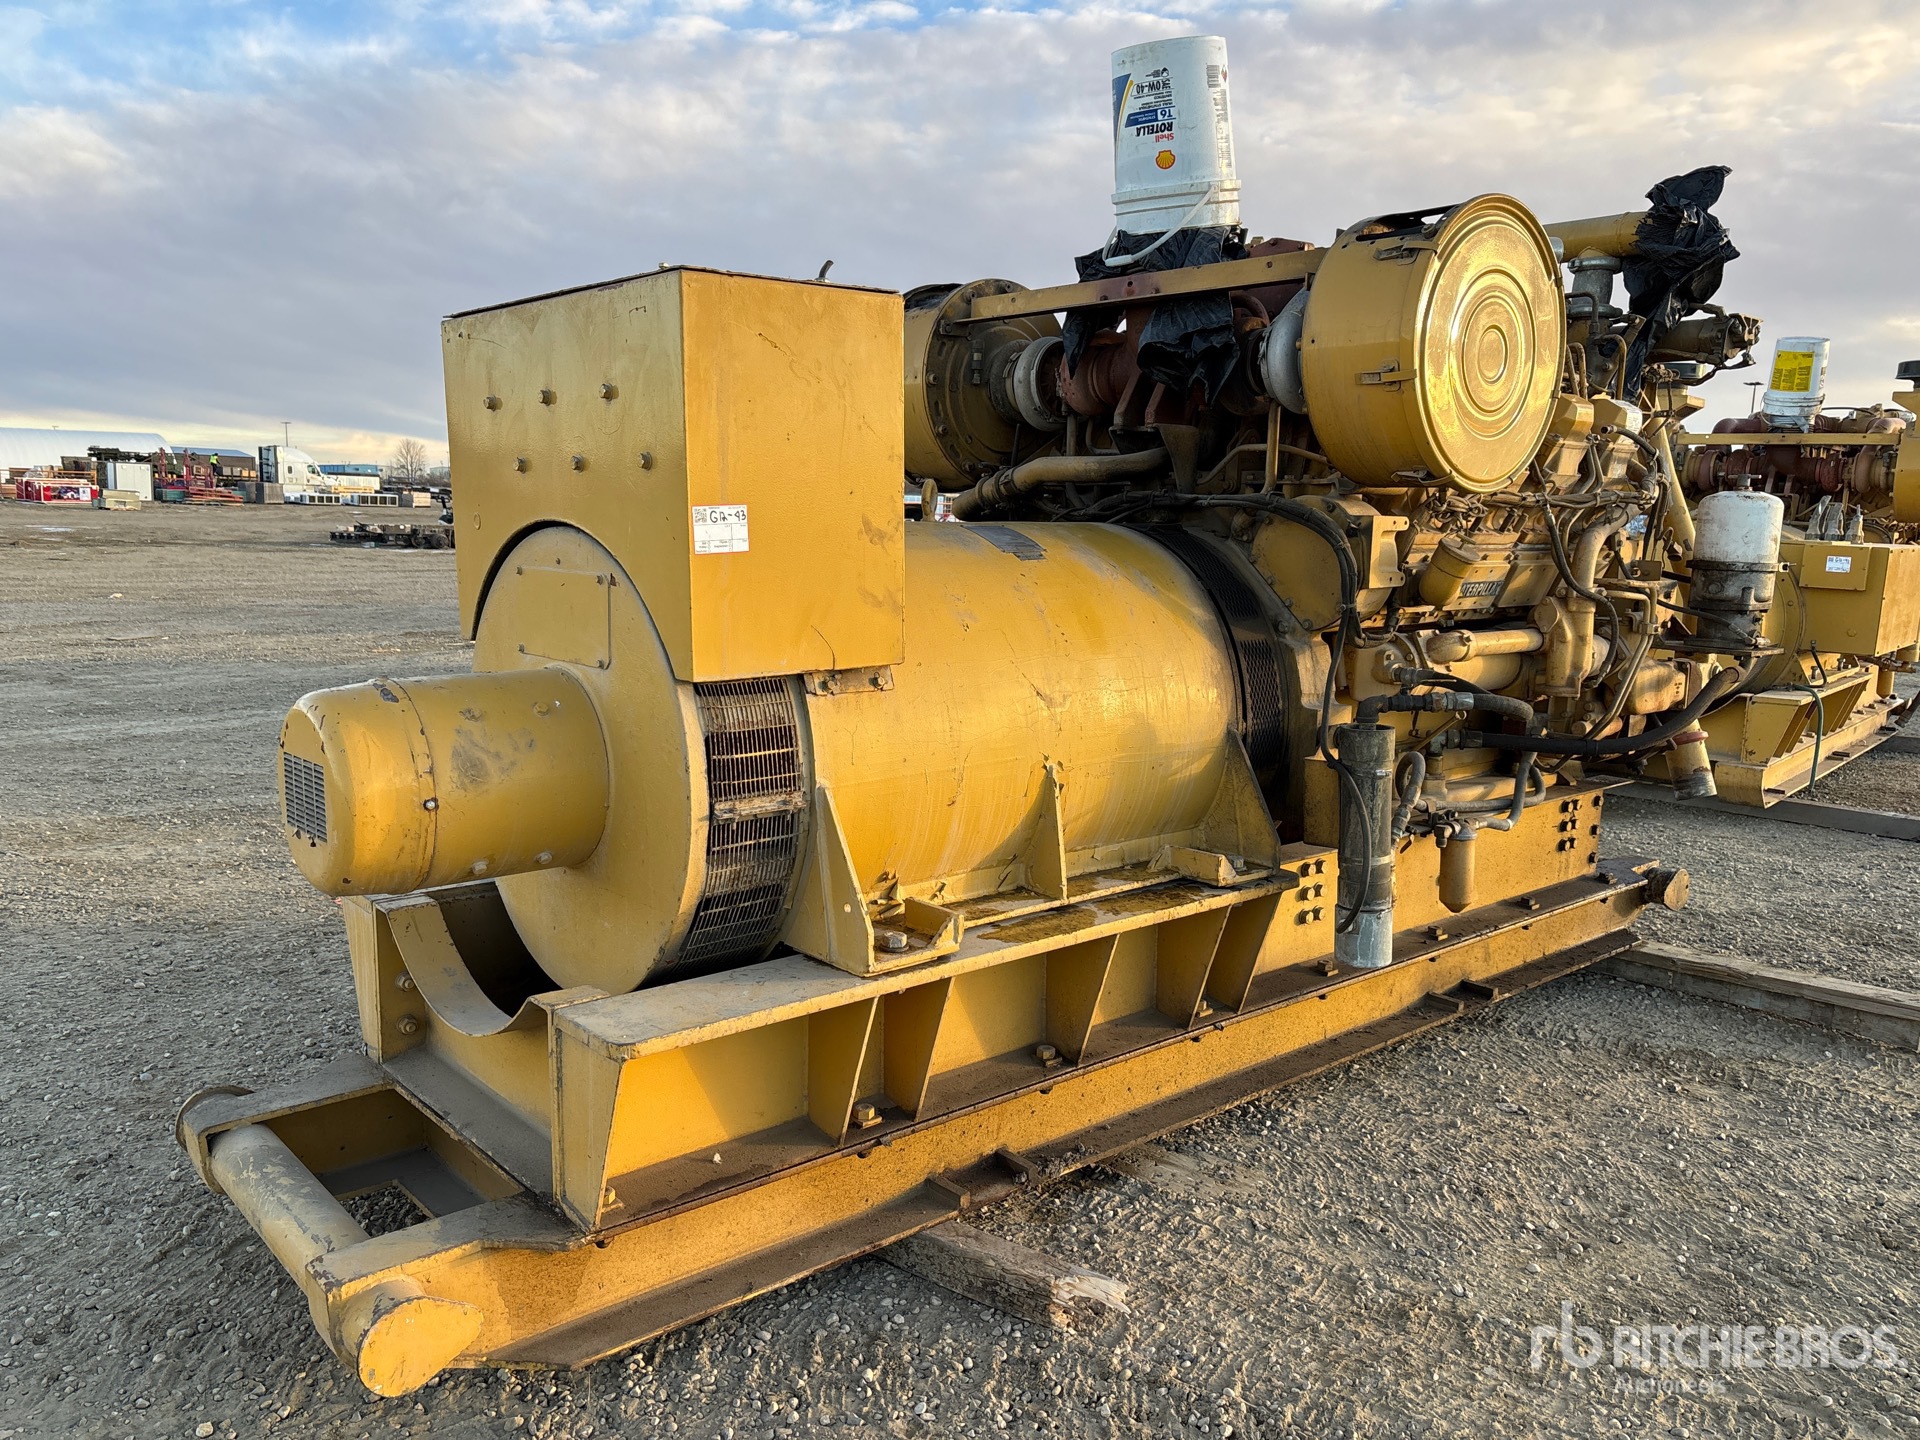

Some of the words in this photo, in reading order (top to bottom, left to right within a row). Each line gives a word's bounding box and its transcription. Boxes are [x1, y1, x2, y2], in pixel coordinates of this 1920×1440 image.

[1136, 80, 1161, 94] 0W-40
[1160, 109, 1172, 119] T6
[1135, 121, 1173, 137] ROTELLA
[1155, 133, 1174, 142] Shell
